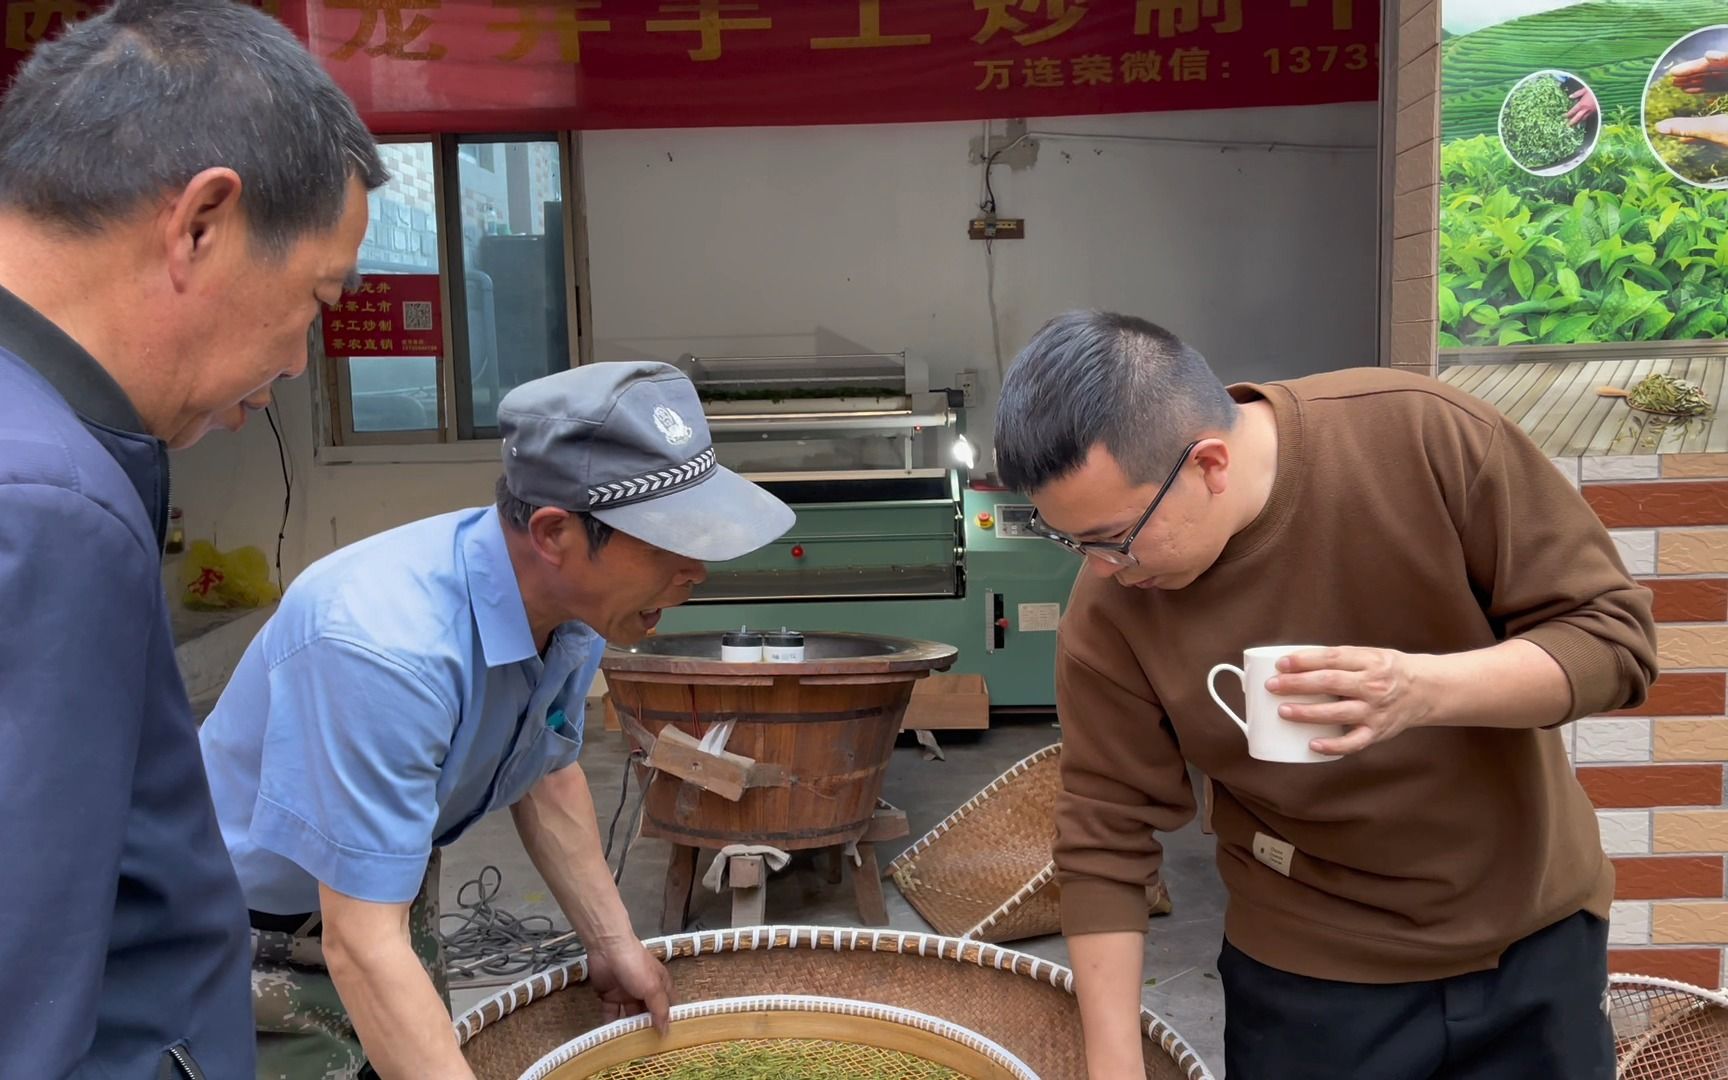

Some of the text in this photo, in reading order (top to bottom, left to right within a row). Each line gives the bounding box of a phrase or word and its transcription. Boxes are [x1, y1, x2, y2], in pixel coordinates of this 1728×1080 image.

[1263, 44, 1379, 74] 1373
[331, 320, 392, 331] 手工炒制
[332, 339, 393, 351] 茶农直销
